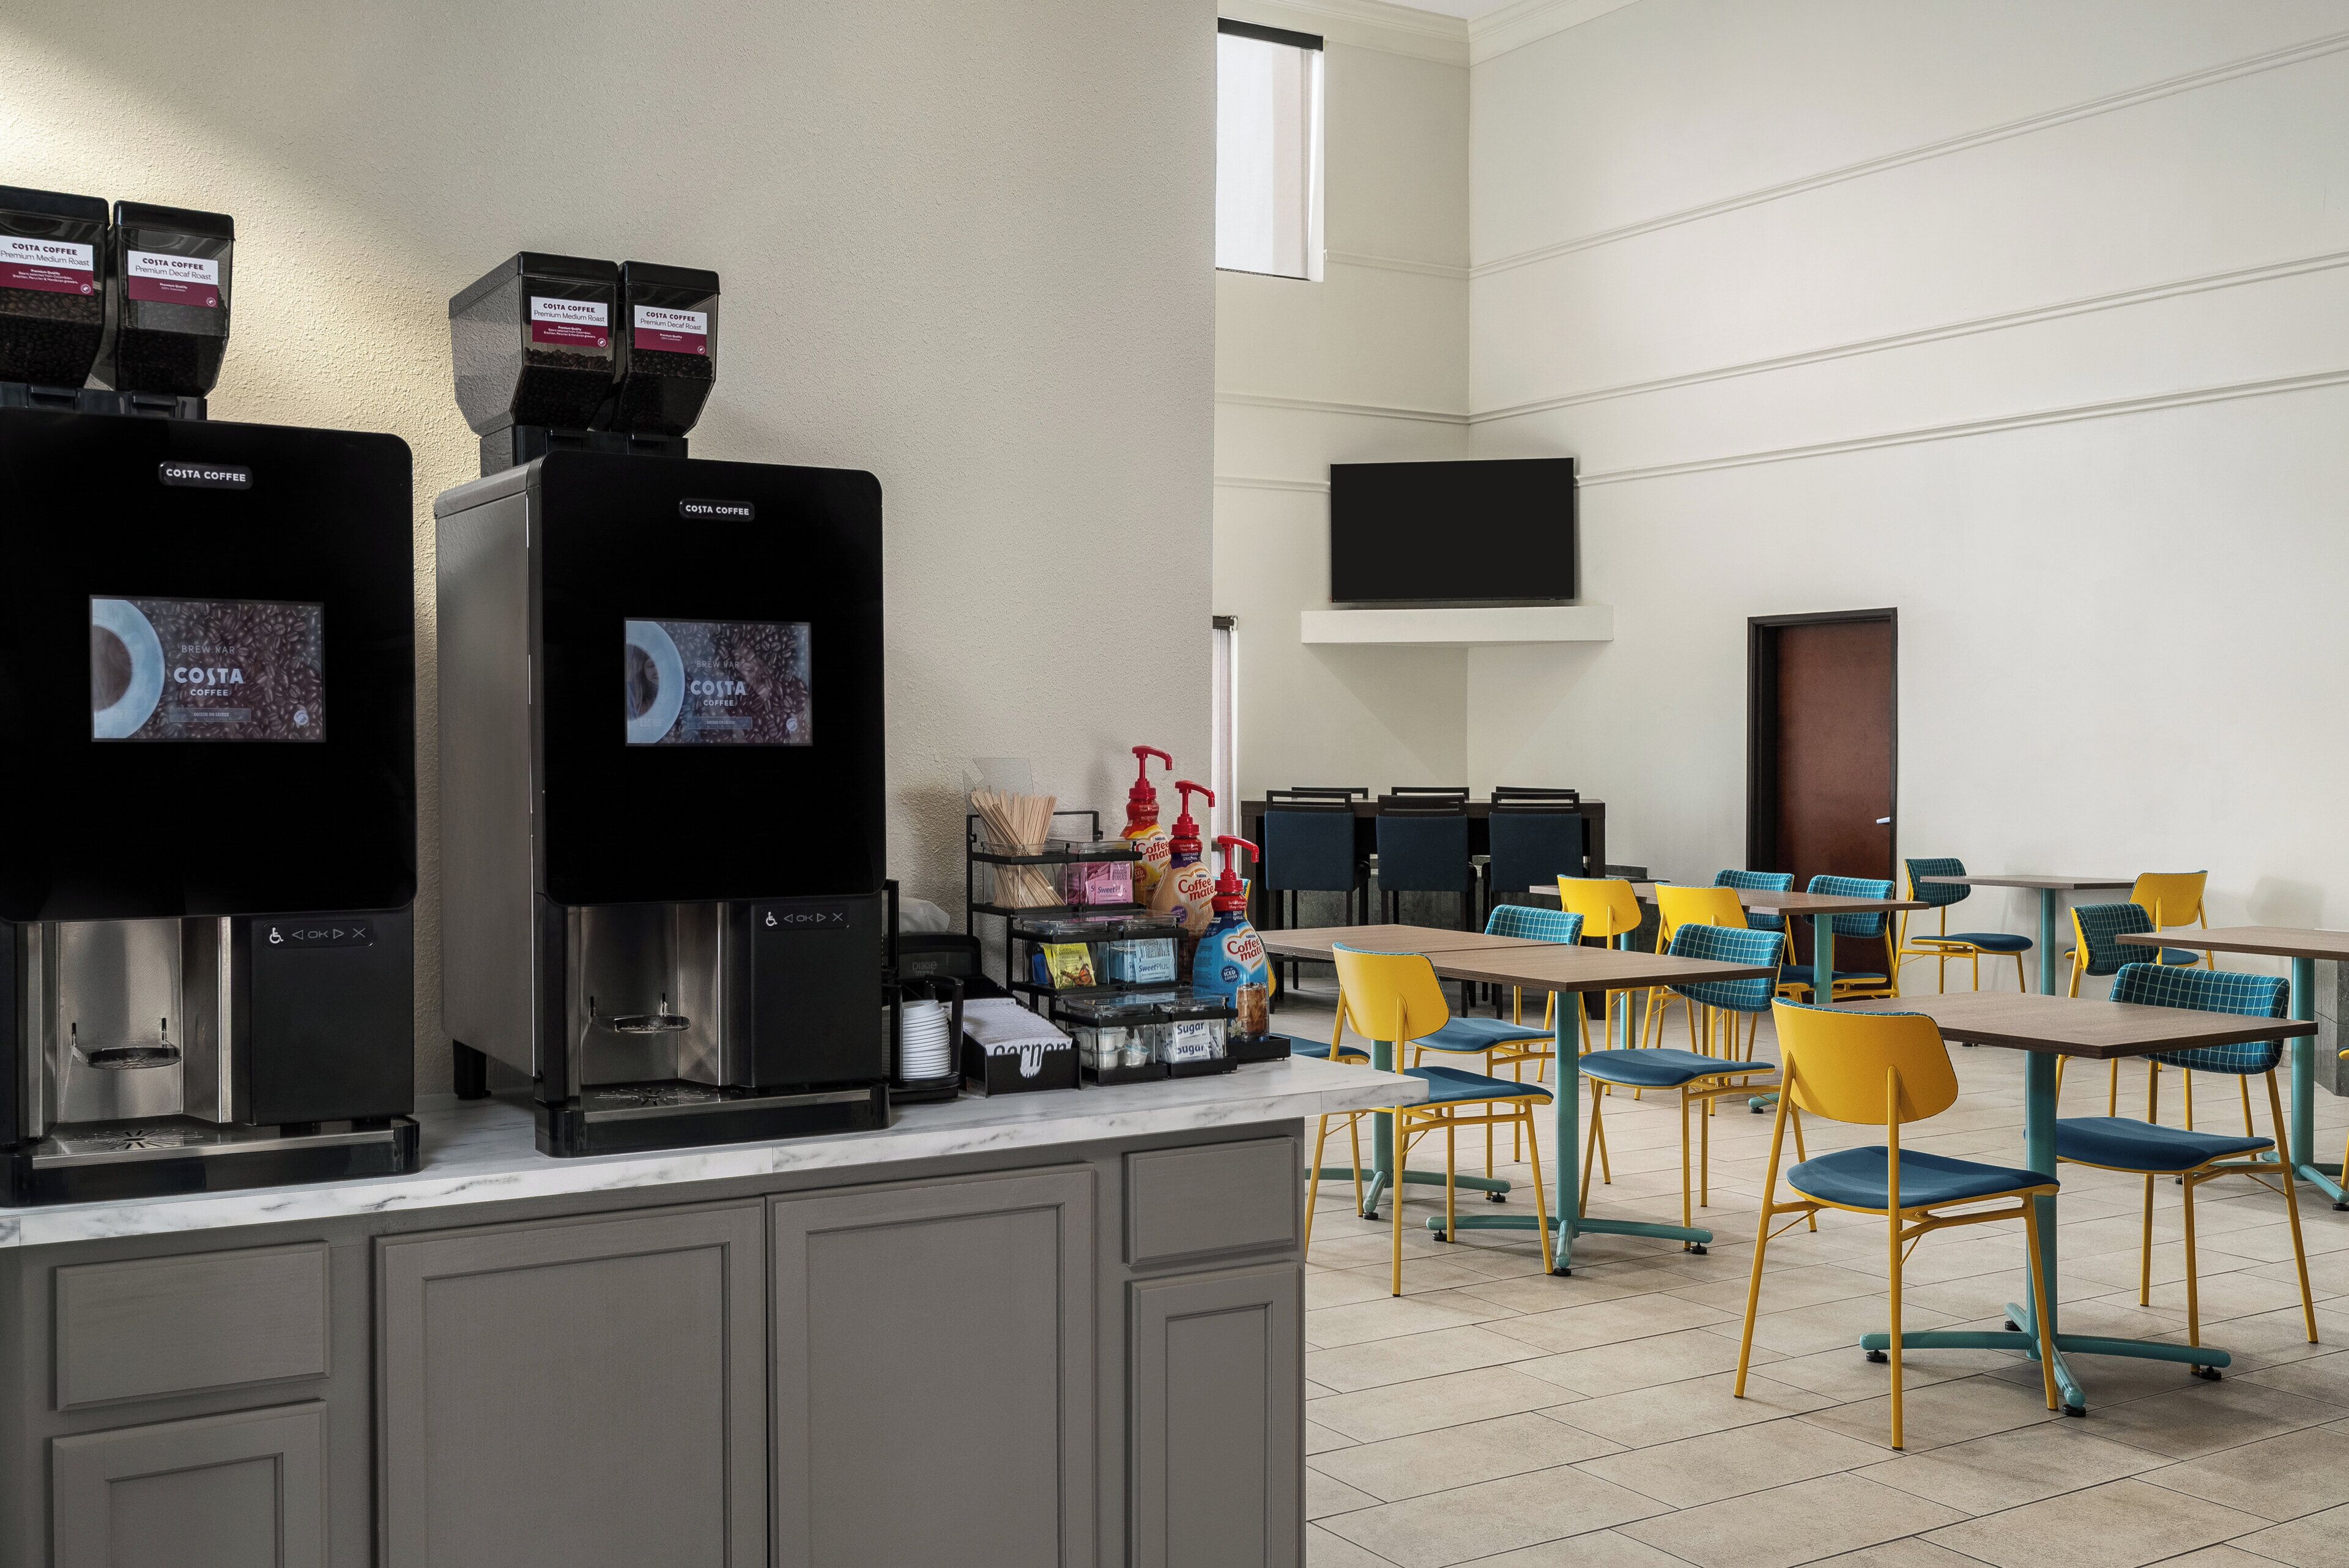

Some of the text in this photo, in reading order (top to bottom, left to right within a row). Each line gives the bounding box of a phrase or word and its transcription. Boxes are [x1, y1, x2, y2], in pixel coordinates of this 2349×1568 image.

[12, 243, 78, 256] COSTA COFFEE
[1, 250, 89, 266] Premium Medium Roast
[135, 266, 167, 275] Premium
[172, 261, 204, 270] COFFEE
[166, 469, 246, 481] COSTA COFFEE
[686, 505, 749, 515] COSTA COFFEE
[182, 645, 210, 653] BREW
[174, 667, 244, 686] COSTA
[690, 680, 746, 697] COSTA
[1136, 841, 1169, 855] Coffee
[1178, 878, 1211, 893] Coffee
[1189, 885, 1214, 901] mate
[1227, 938, 1260, 954] Coffee
[1240, 946, 1263, 962] mate
[1178, 1022, 1204, 1034] Sugar
